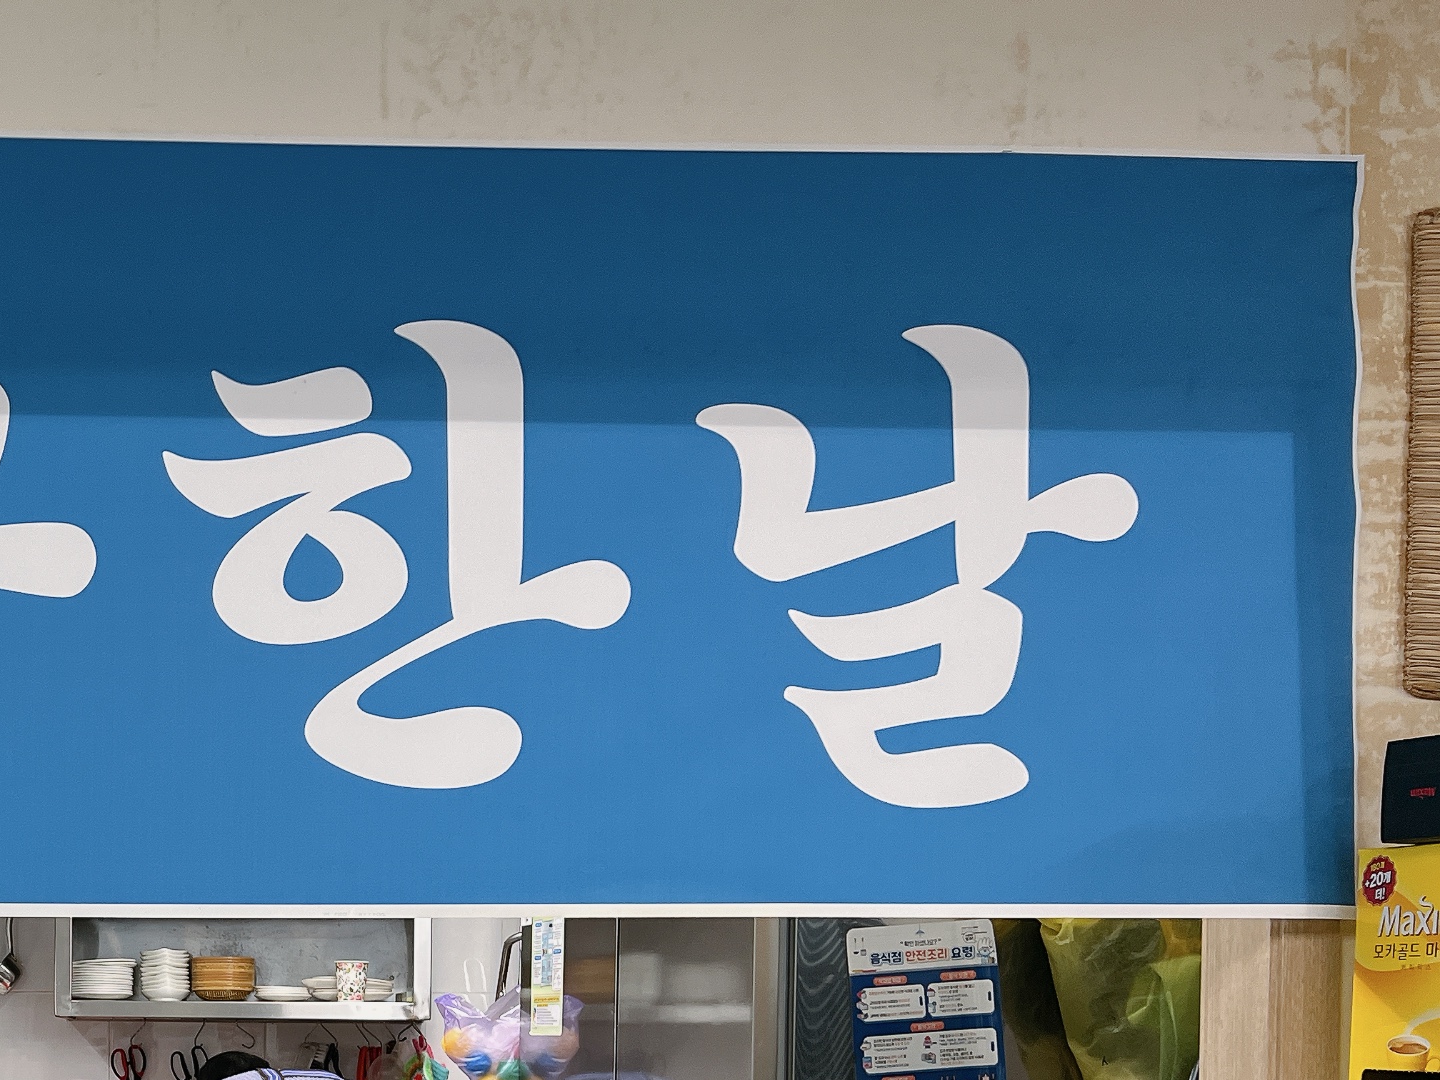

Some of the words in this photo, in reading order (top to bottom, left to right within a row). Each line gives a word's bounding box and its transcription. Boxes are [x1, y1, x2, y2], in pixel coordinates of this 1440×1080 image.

[870, 951, 903, 964] 음식점
[905, 948, 948, 962] 안전조리
[951, 946, 973, 959] 요령
[1374, 942, 1421, 960] 모카골드
